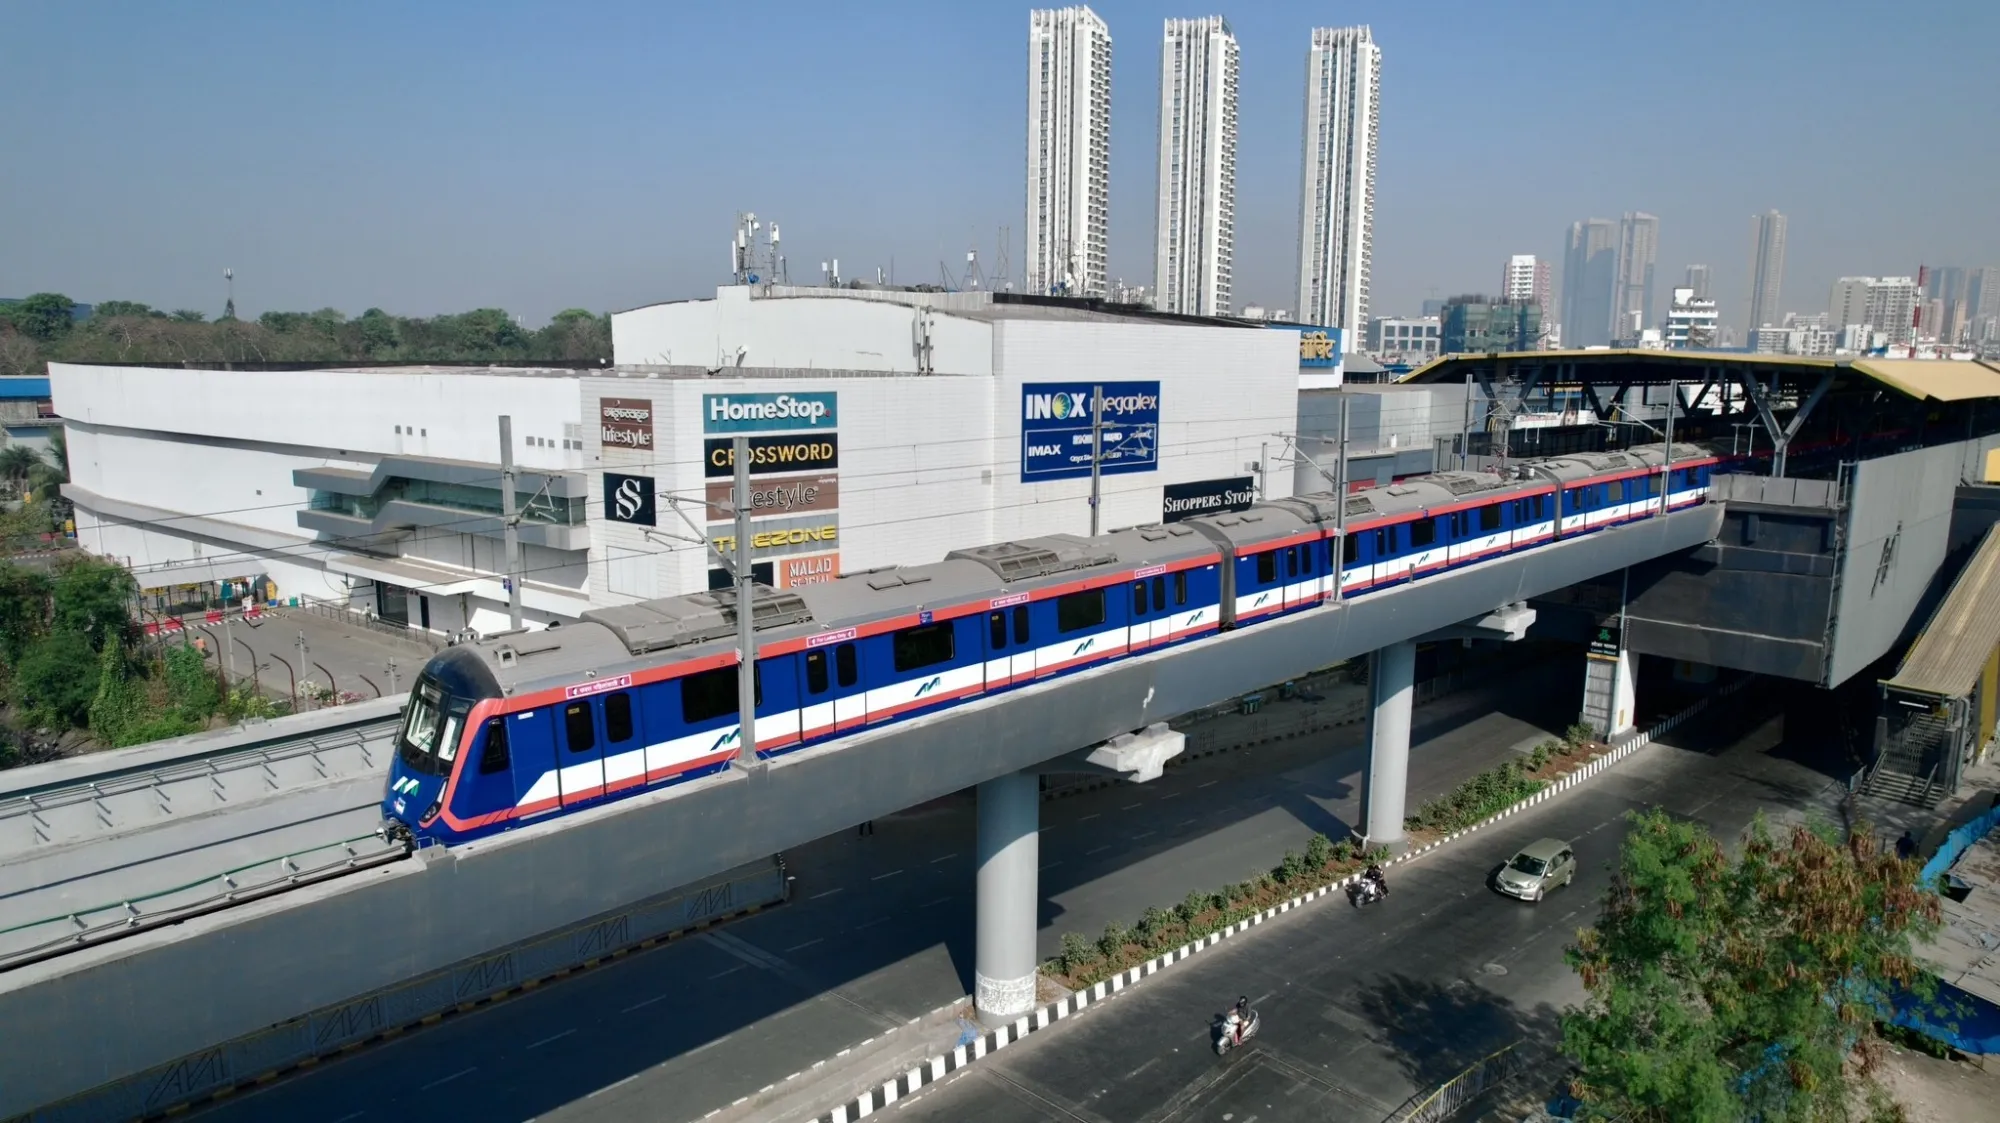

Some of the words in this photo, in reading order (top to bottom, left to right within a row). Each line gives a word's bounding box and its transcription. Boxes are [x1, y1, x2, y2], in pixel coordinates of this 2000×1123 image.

[1025, 391, 1086, 420] INOX
[602, 424, 651, 447] lifestyle
[1028, 444, 1061, 457] IMAX
[729, 482, 814, 510] lestyle
[712, 525, 836, 553] TIEZONE
[789, 557, 832, 578] MALAD
